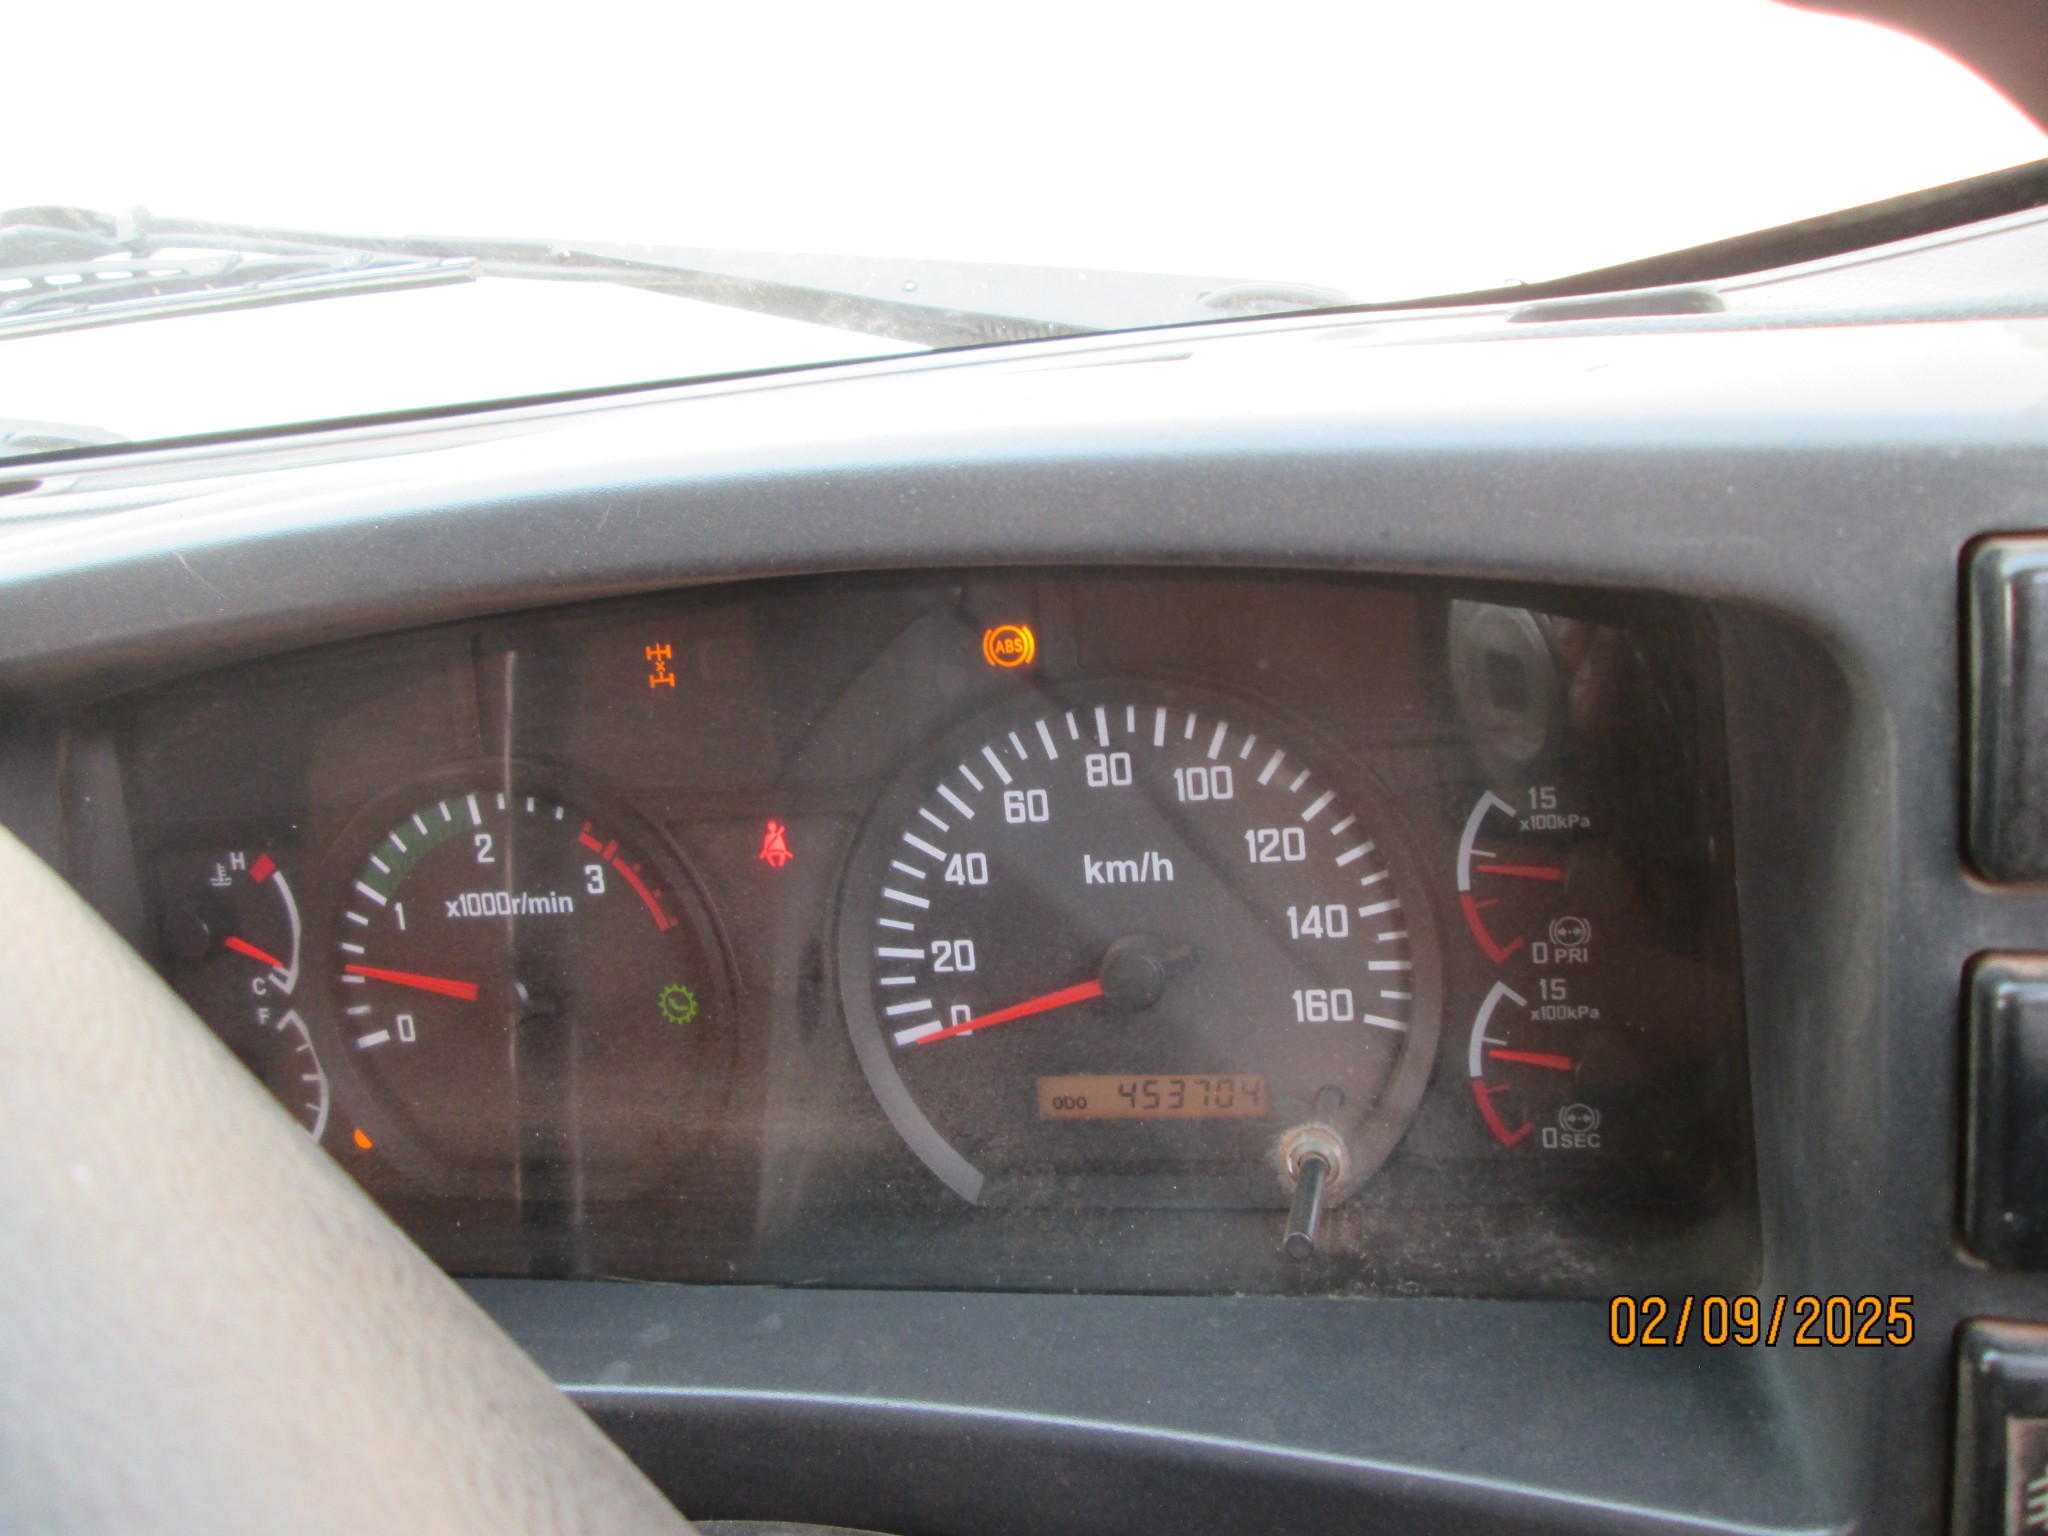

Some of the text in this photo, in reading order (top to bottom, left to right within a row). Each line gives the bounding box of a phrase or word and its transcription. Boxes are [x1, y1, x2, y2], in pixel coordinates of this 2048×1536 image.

[995, 637, 1023, 654] ABS
[1086, 753, 1132, 787] 80
[1173, 765, 1233, 803] 100
[1003, 790, 1049, 823] 60
[1528, 786, 1557, 810] 15
[1519, 814, 1591, 832] x100kPa
[474, 834, 494, 863] 2
[1245, 827, 1306, 863] 120
[230, 852, 246, 870] H
[945, 852, 988, 885] 40
[1084, 852, 1174, 884] km/h
[585, 864, 605, 895] 3
[394, 902, 406, 930] 1
[446, 892, 573, 918] x1000r/min
[1287, 904, 1348, 939] 140
[932, 940, 976, 972] 20
[1532, 942, 1589, 964] 0 PRI
[252, 977, 267, 995] C
[1539, 978, 1567, 1000] 15
[257, 1008, 270, 1024] F
[1292, 988, 1354, 1022] 160
[1530, 1005, 1600, 1021] x100kPa
[396, 1014, 416, 1042] 0
[950, 1004, 973, 1035] 0
[1053, 1079, 1260, 1110] ODO 453704
[1542, 1127, 1601, 1149] 0 SEC
